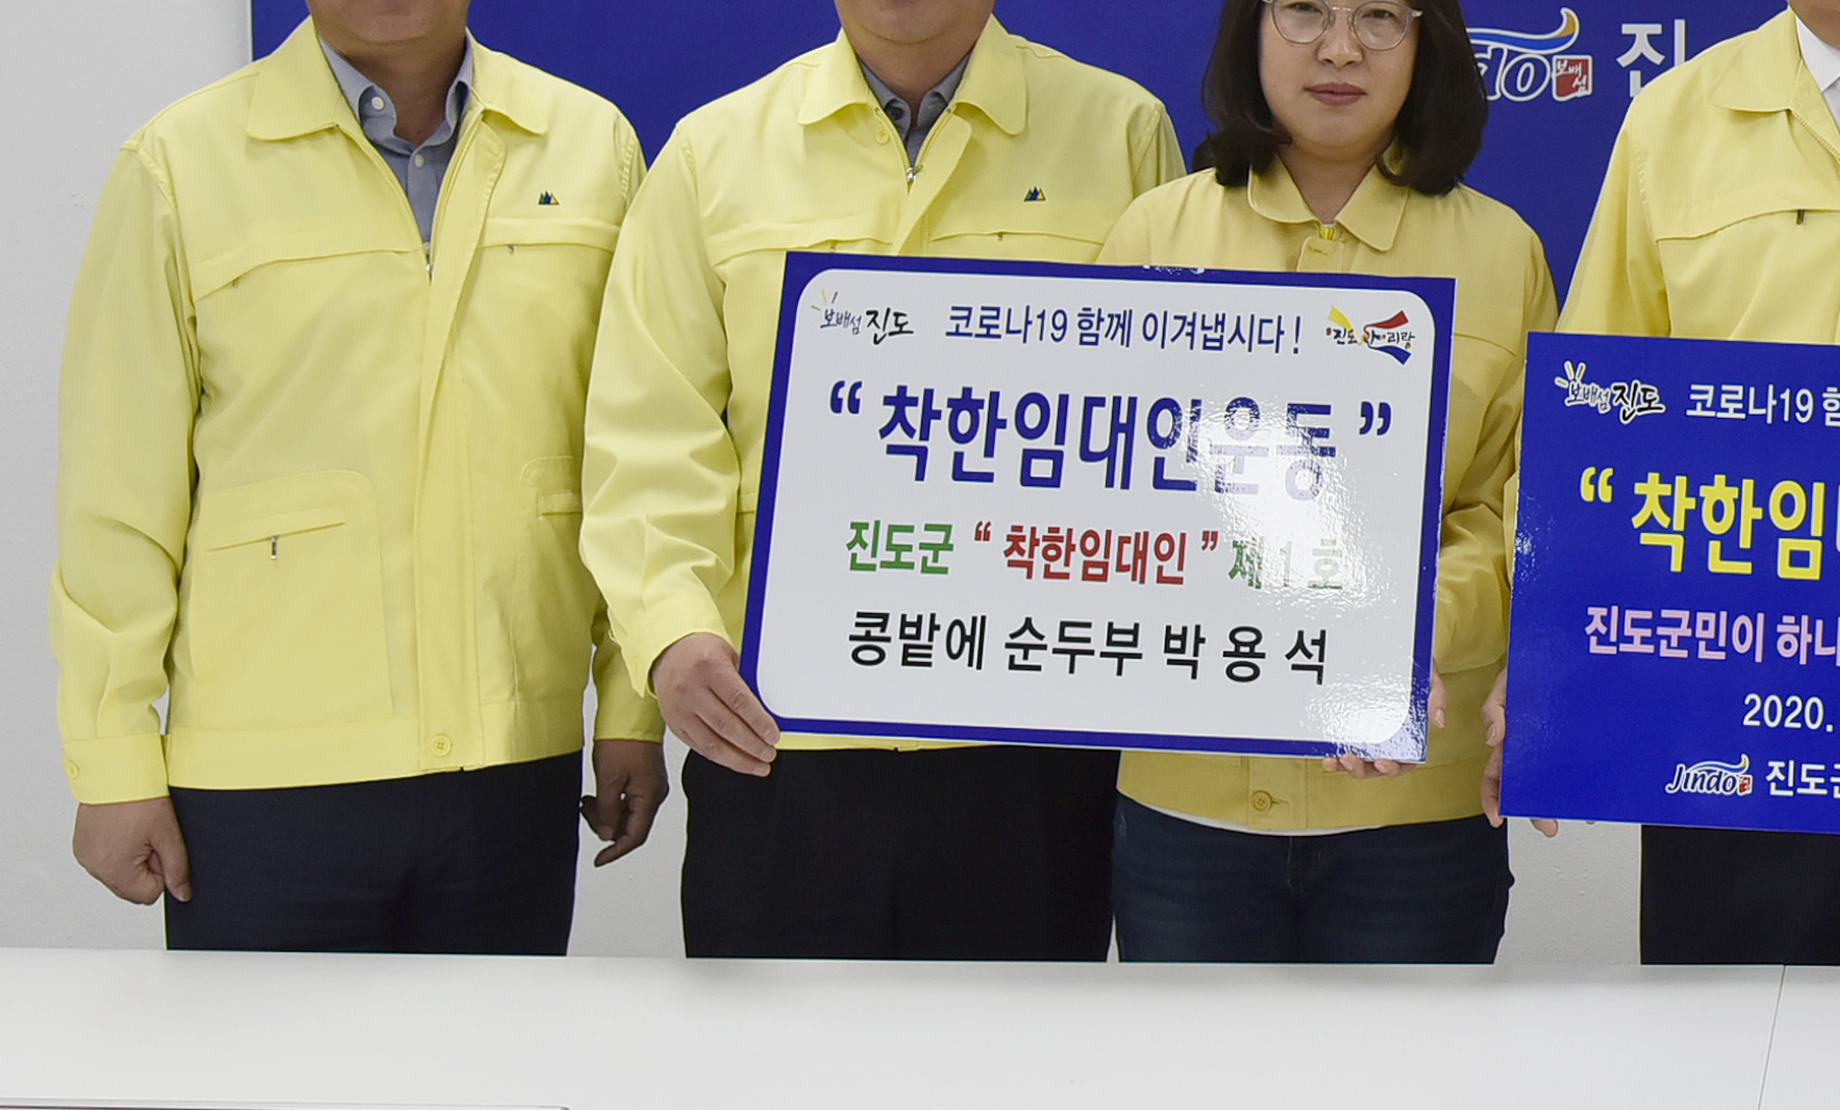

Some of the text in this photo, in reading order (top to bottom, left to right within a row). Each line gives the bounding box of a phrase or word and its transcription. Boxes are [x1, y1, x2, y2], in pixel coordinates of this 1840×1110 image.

[865, 308, 914, 346] 진도
[945, 305, 1068, 347] 코로나19
[1076, 307, 1134, 348] 함께
[1612, 382, 1664, 421] 진도
[1686, 383, 1815, 424] 코로나19
[845, 519, 954, 575] 진도군
[848, 610, 987, 671] 콩밭에
[1005, 616, 1144, 676] 순두부
[1584, 607, 1764, 663] 진도군민이
[1743, 693, 1834, 734] 2020.
[1668, 766, 1738, 793] Jindo
